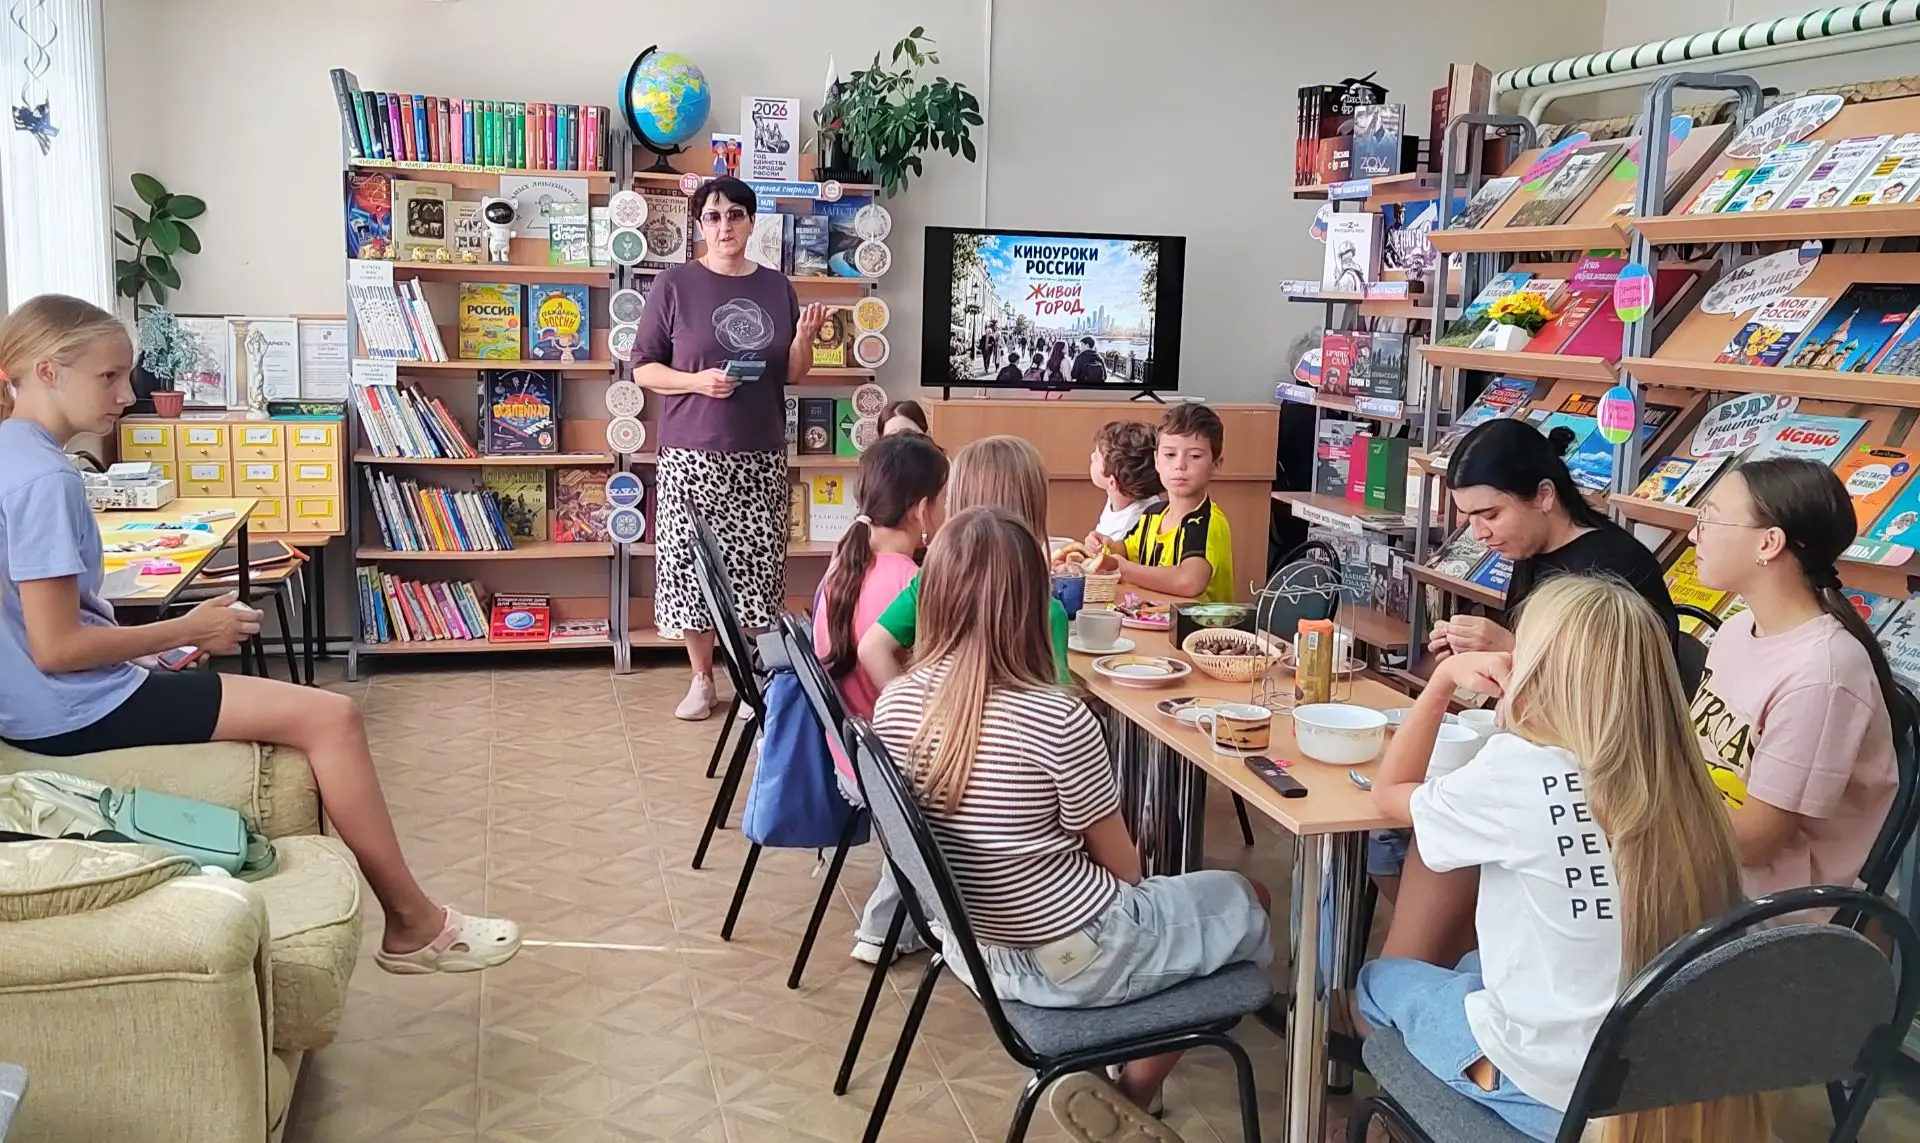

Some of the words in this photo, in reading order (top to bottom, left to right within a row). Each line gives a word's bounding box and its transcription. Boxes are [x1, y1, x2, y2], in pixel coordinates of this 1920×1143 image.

[754, 103, 788, 117] 2026
[1341, 103, 1354, 115] фр
[358, 156, 393, 167] книгой
[404, 161, 424, 171] мир
[426, 162, 482, 172] интересных
[485, 166, 505, 174] наук
[683, 178, 698, 188] 190
[782, 186, 815, 196] страна!
[511, 184, 530, 199] АМЫХ
[532, 181, 579, 202] ЛЮБОЗНАТЕЛ
[647, 203, 686, 214] ОССИИ
[1013, 244, 1099, 262] КИНОУРОКИ
[1025, 260, 1086, 276] РОССИИ
[1574, 271, 1619, 282] образовани
[1728, 266, 1806, 296] БУДУЩЕЕ
[1025, 282, 1082, 301] ЖИВОЙ
[1735, 283, 1793, 305] страны
[467, 304, 515, 316] РОССИЯ
[557, 301, 563, 310] Я
[1035, 298, 1086, 316] ГОРОД
[1777, 298, 1809, 309] МОЯ
[1759, 308, 1811, 320] РОССИЯ
[543, 317, 576, 329] РОССИИ
[492, 404, 551, 418] ВСЕЛЕННАЯ
[1719, 394, 1777, 421] БУДУ
[1704, 412, 1779, 442] учиться
[1708, 433, 1738, 451] НА
[1739, 425, 1760, 448] 5
[1849, 479, 1884, 489] ЖИЗНЬ?
[1868, 471, 1890, 481] ТАКОЕ
[1847, 544, 1881, 559] ть!
[1542, 772, 1583, 796] PE
[1549, 802, 1592, 826] PE
[1557, 833, 1602, 857] PE
[1565, 865, 1609, 889] PE
[1571, 898, 1614, 920] PE
